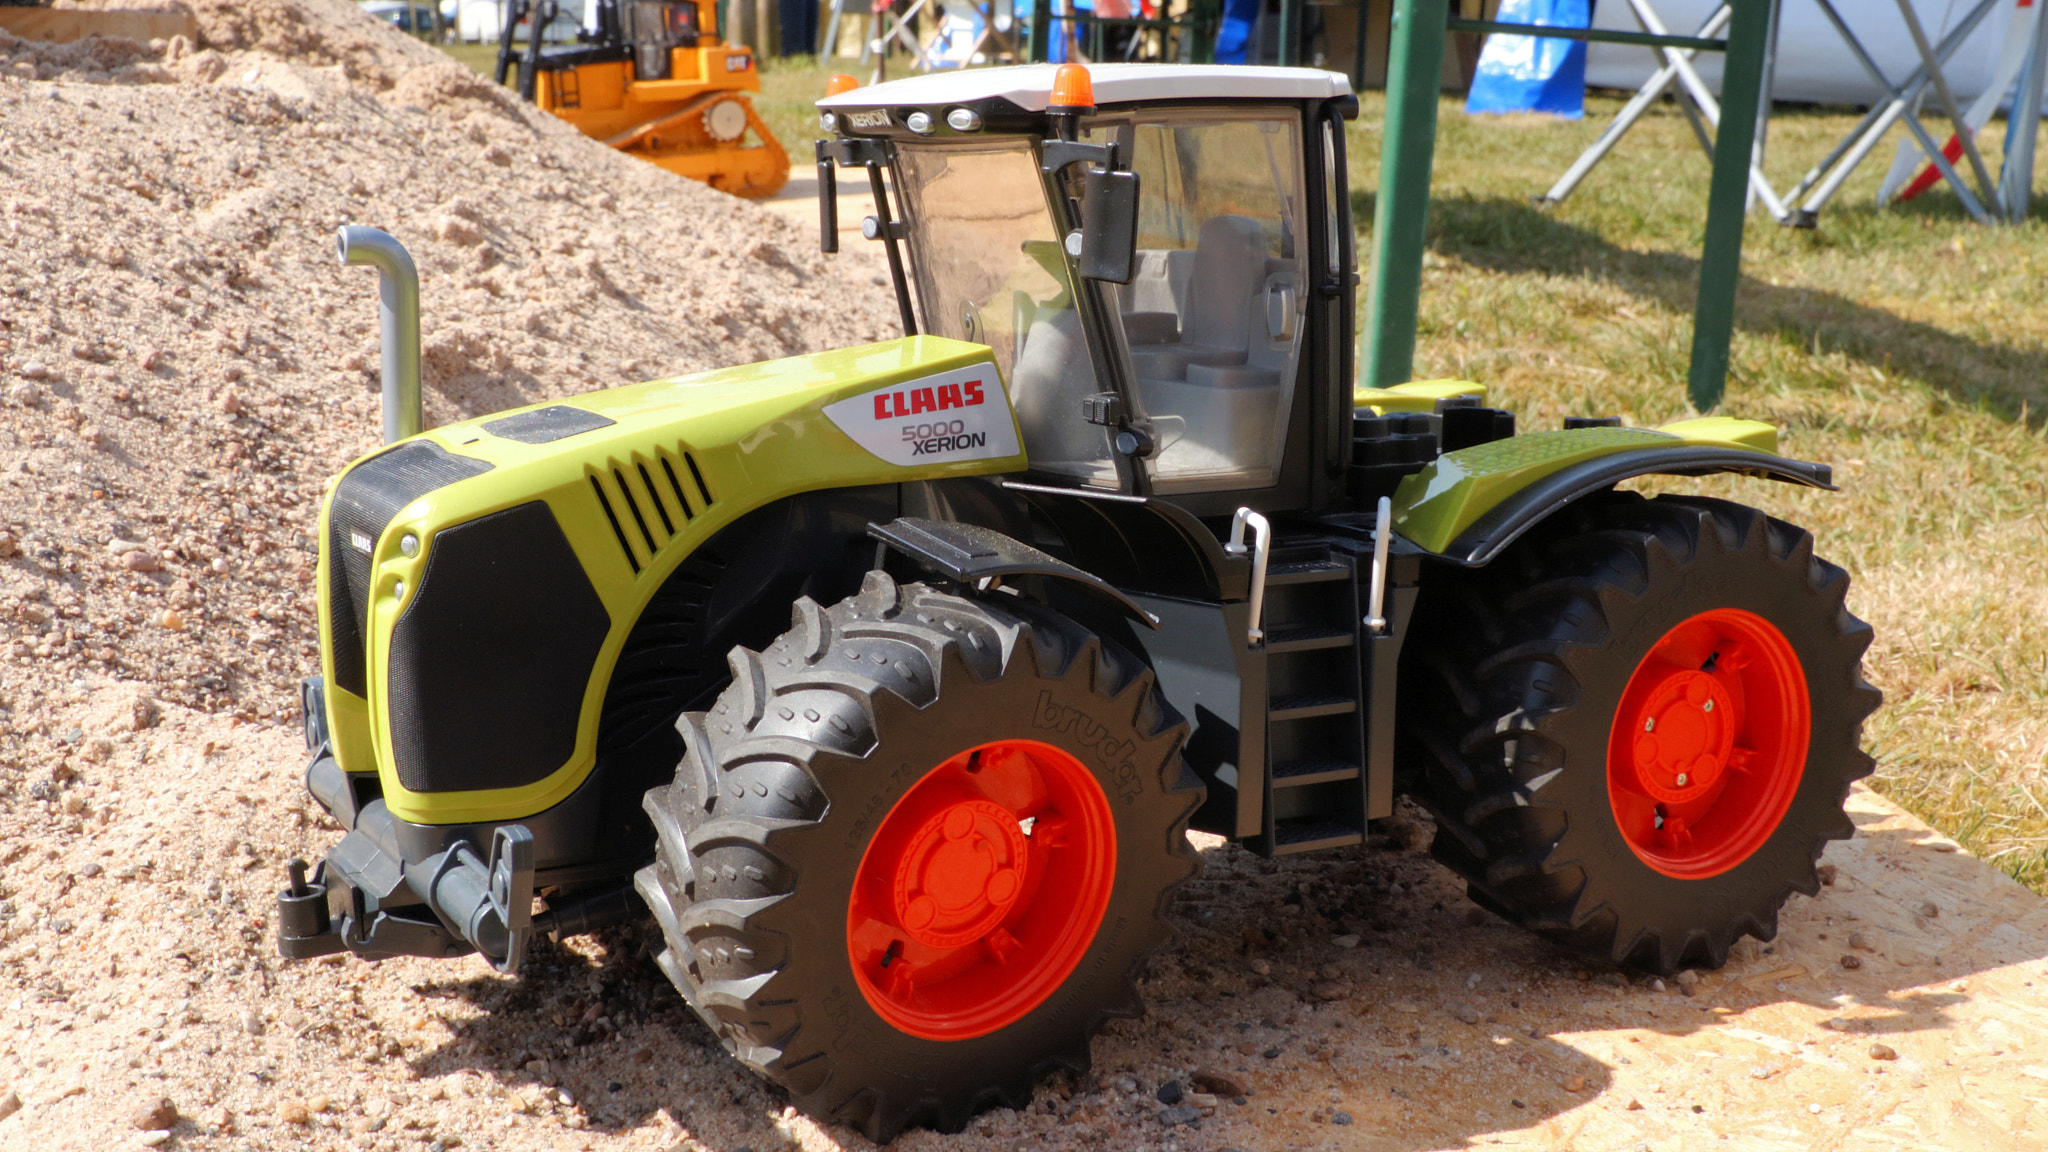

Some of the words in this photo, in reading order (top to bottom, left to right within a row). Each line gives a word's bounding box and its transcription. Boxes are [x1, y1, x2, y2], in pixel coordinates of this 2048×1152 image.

[843, 109, 892, 128] XERION
[874, 380, 984, 420] CLAAS
[902, 420, 964, 441] 5000
[913, 432, 986, 456] XERION
